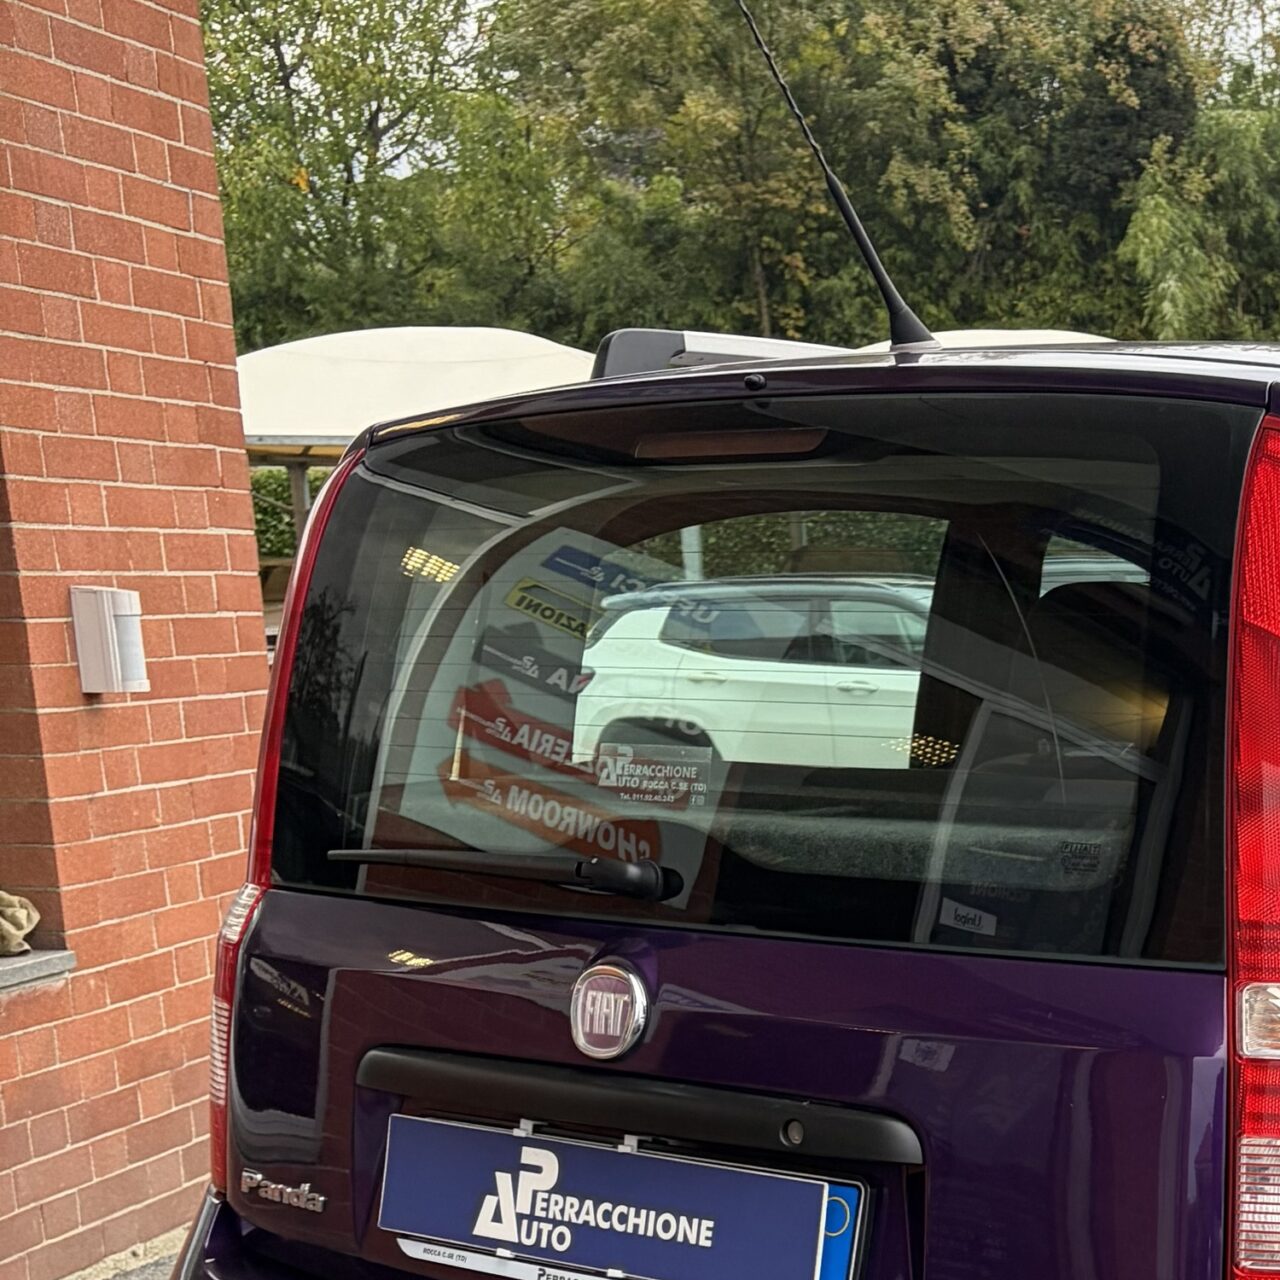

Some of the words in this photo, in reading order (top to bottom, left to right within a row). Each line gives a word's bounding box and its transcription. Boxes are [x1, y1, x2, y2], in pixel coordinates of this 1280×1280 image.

[598, 756, 640, 787] AUTO
[616, 746, 698, 778] PERRACCHIONE
[584, 990, 629, 1036] FIAT
[240, 1167, 328, 1213] Panda
[472, 1171, 572, 1252] AUTO
[515, 1145, 714, 1248] PERRACCHIONE
